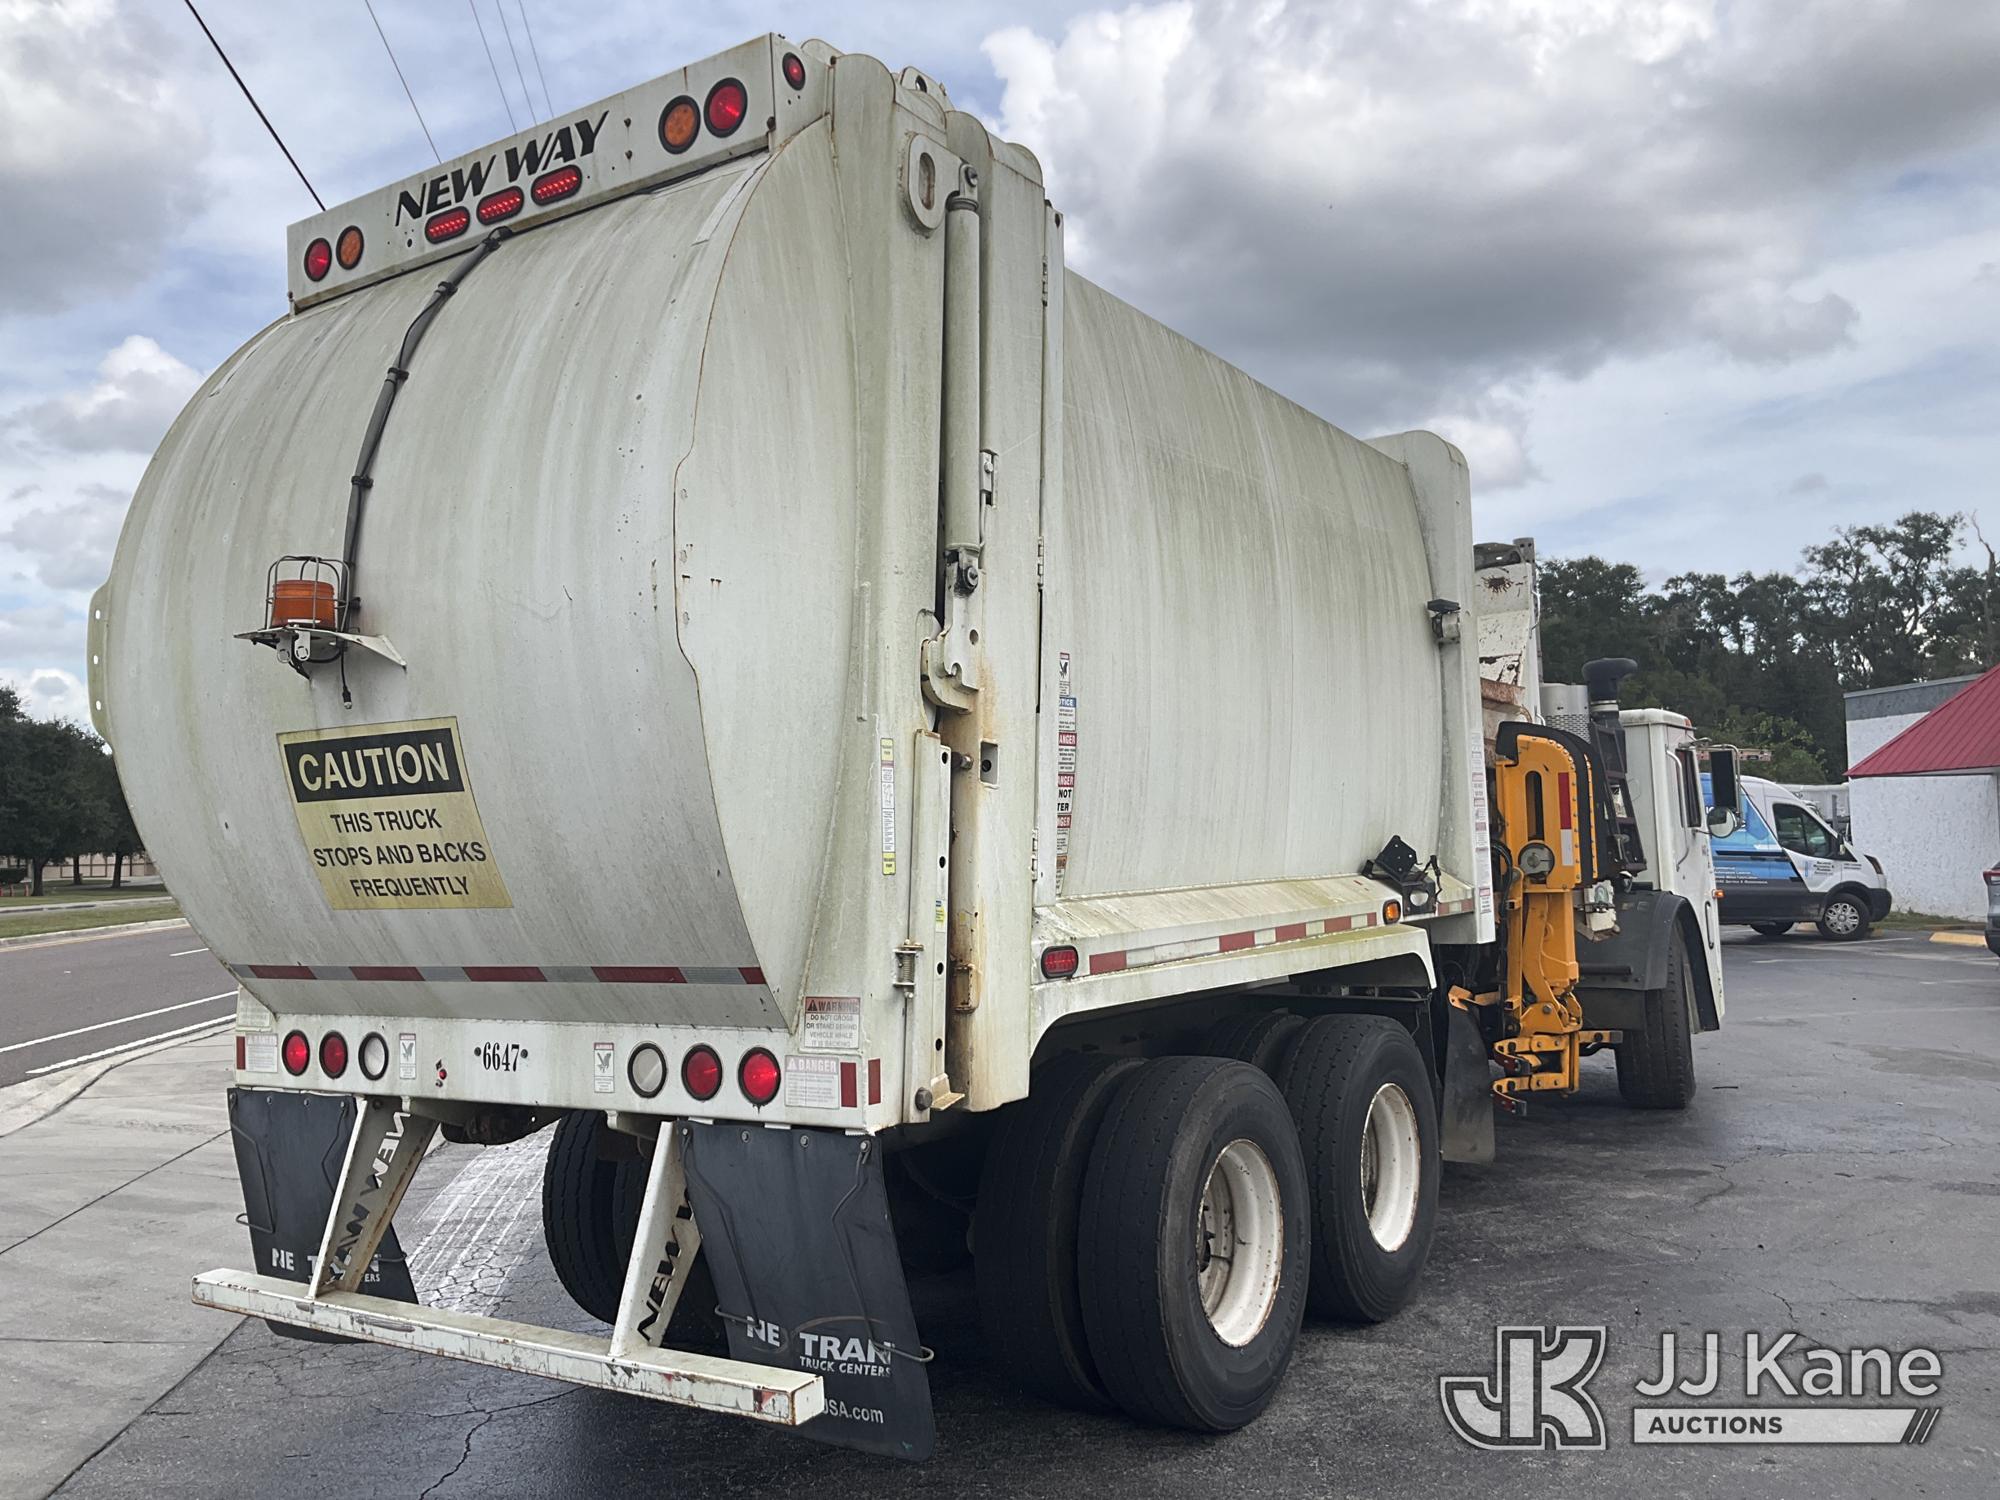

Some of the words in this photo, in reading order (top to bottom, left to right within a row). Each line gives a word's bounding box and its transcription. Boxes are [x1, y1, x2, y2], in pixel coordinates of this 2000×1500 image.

[395, 154, 496, 227] NEW
[504, 110, 609, 183] WAY
[299, 742, 449, 791] CAUTION
[1057, 803, 1070, 812] TER
[330, 812, 372, 833] THIS
[374, 808, 442, 831] TRUCK
[313, 846, 372, 867] STOPS
[377, 844, 414, 865] AND
[416, 842, 487, 863] BACKS
[350, 876, 470, 897] FREQUENTLY
[818, 1000, 859, 1012] WARNING
[482, 1042, 520, 1072] 6647
[798, 1058, 837, 1073] DANGER
[637, 1225, 681, 1342] NEW
[799, 1356, 839, 1373] TRUCK
[839, 1362, 892, 1378] CENTERS
